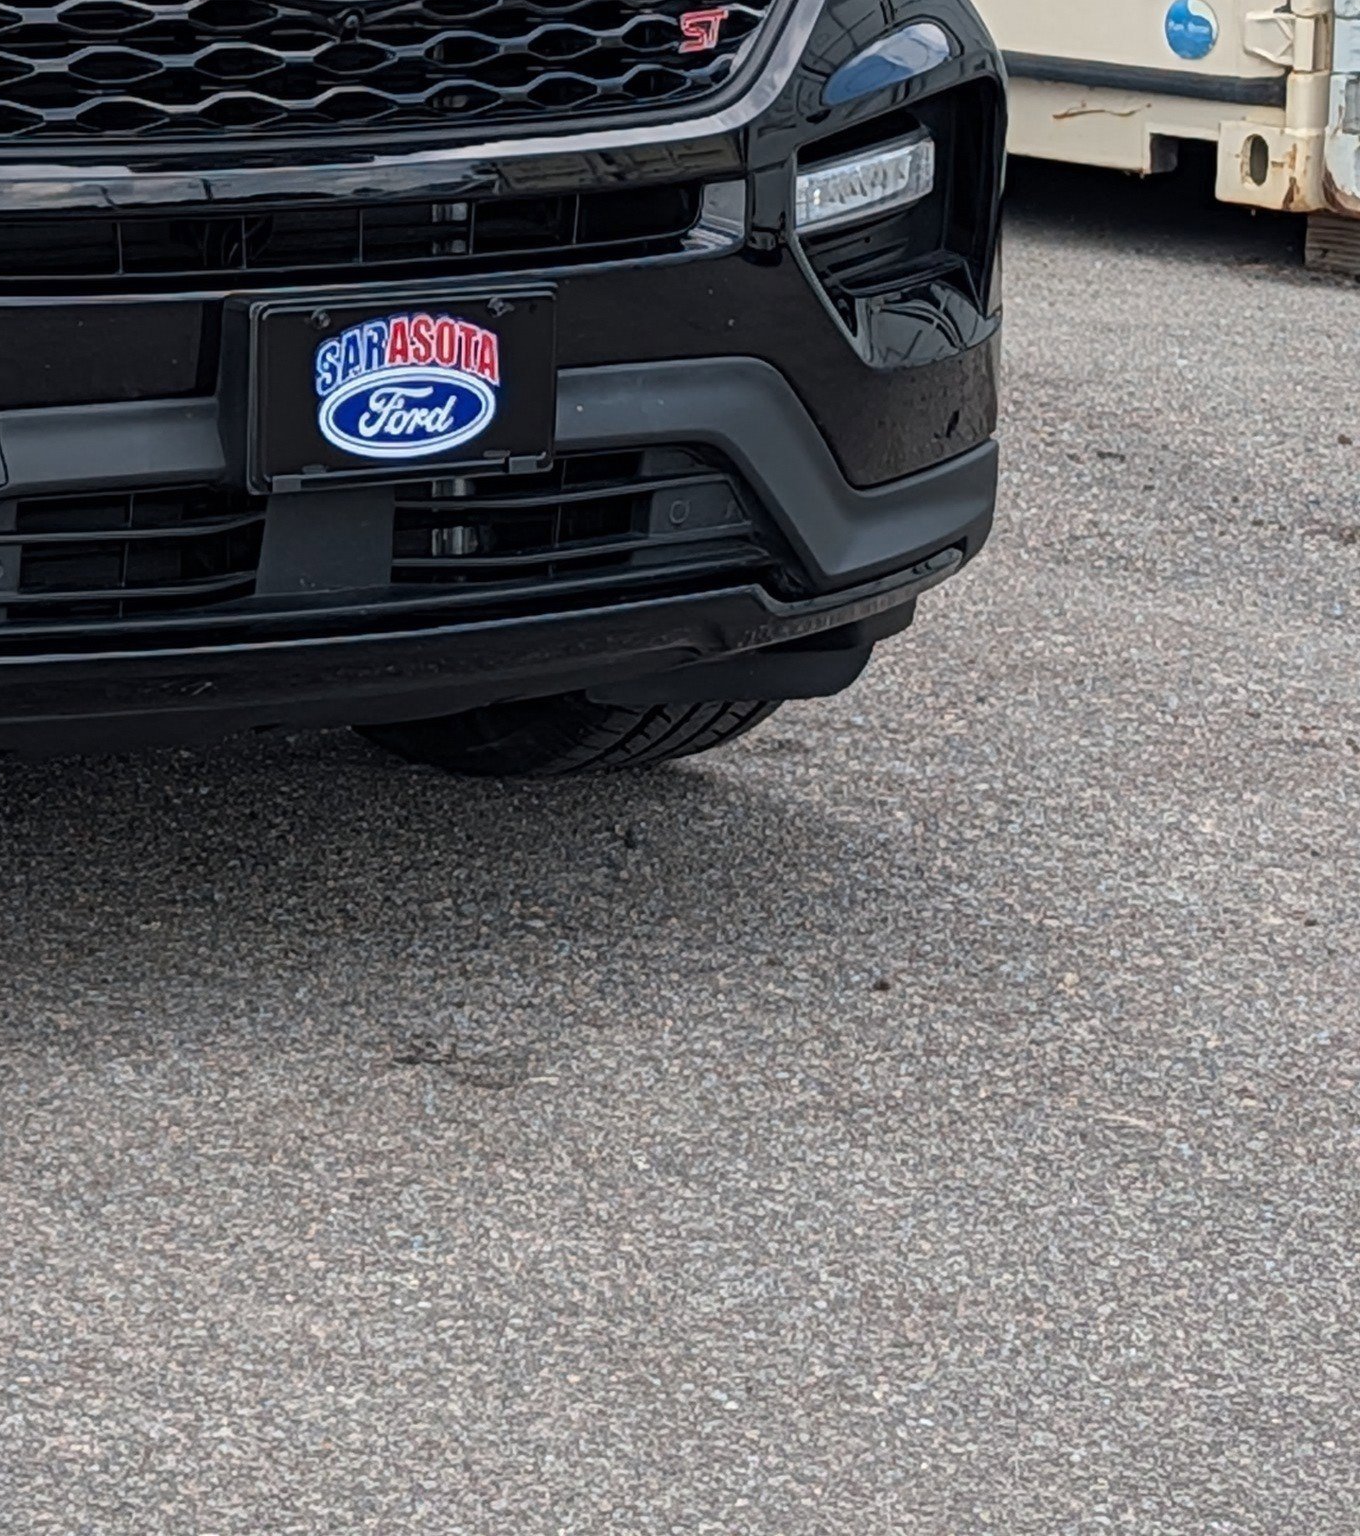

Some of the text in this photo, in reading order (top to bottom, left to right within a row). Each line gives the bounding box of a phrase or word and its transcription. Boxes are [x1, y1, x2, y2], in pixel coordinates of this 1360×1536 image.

[680, 10, 728, 52] ST
[315, 315, 500, 396] SARASOTA
[358, 386, 457, 438] Ford
